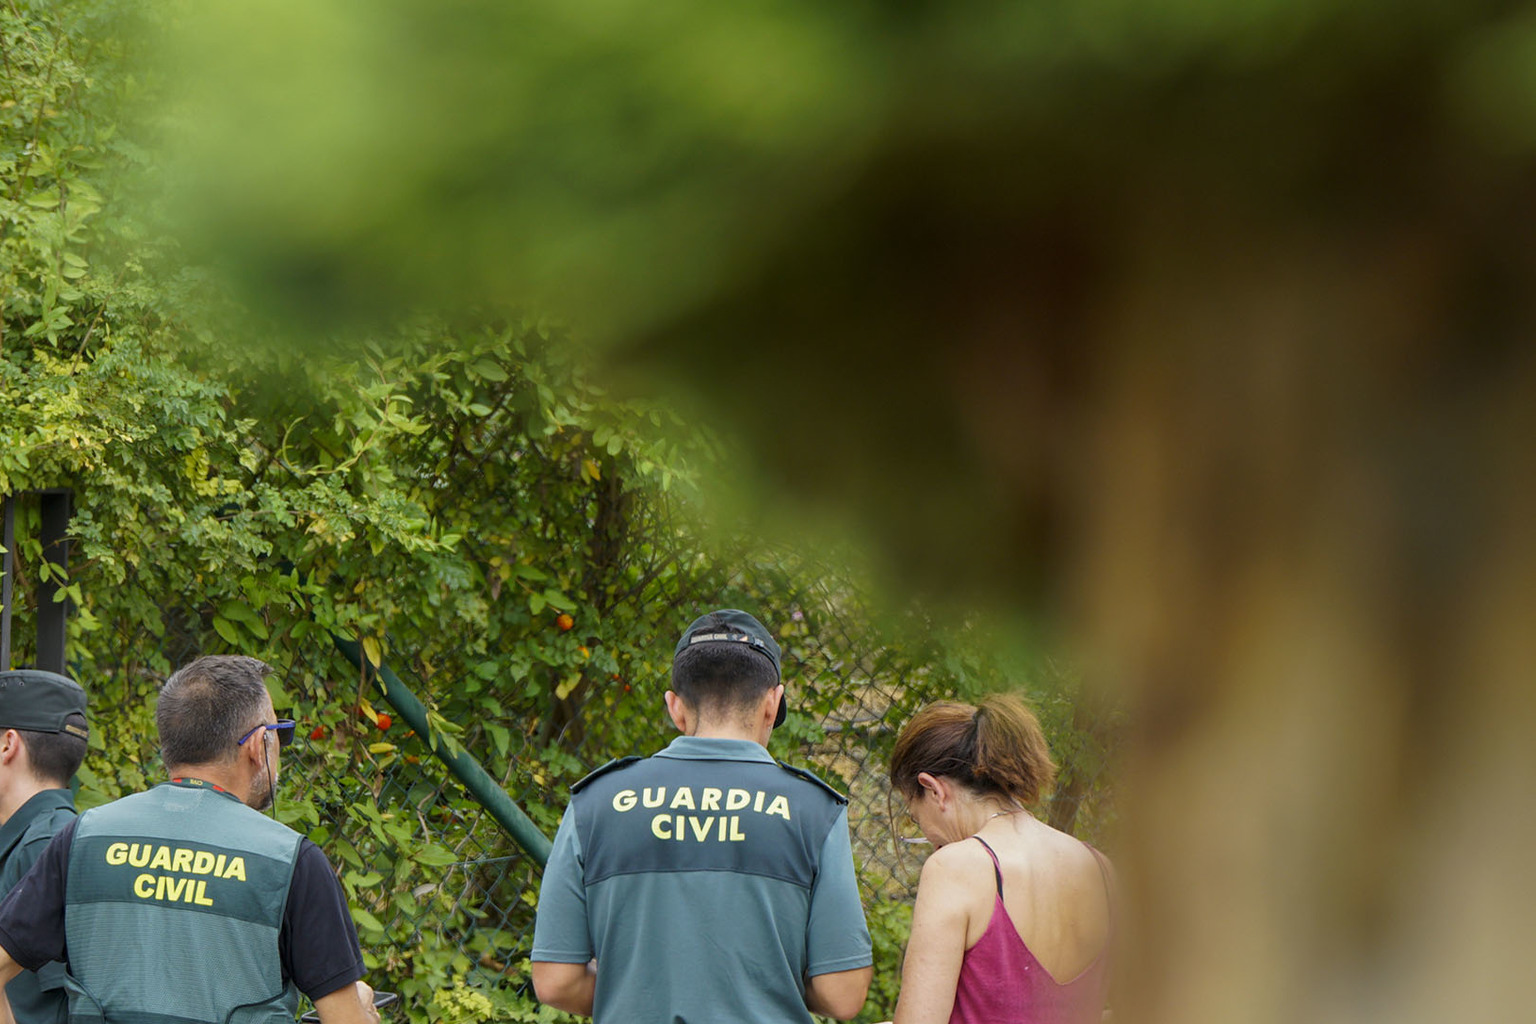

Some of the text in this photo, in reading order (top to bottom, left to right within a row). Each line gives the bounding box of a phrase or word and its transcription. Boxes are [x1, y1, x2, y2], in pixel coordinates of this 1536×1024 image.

[612, 786, 791, 821] GUARDIA
[651, 813, 746, 842] CIVIL
[105, 842, 247, 882] GUARDIA
[133, 873, 214, 907] CIVIL
